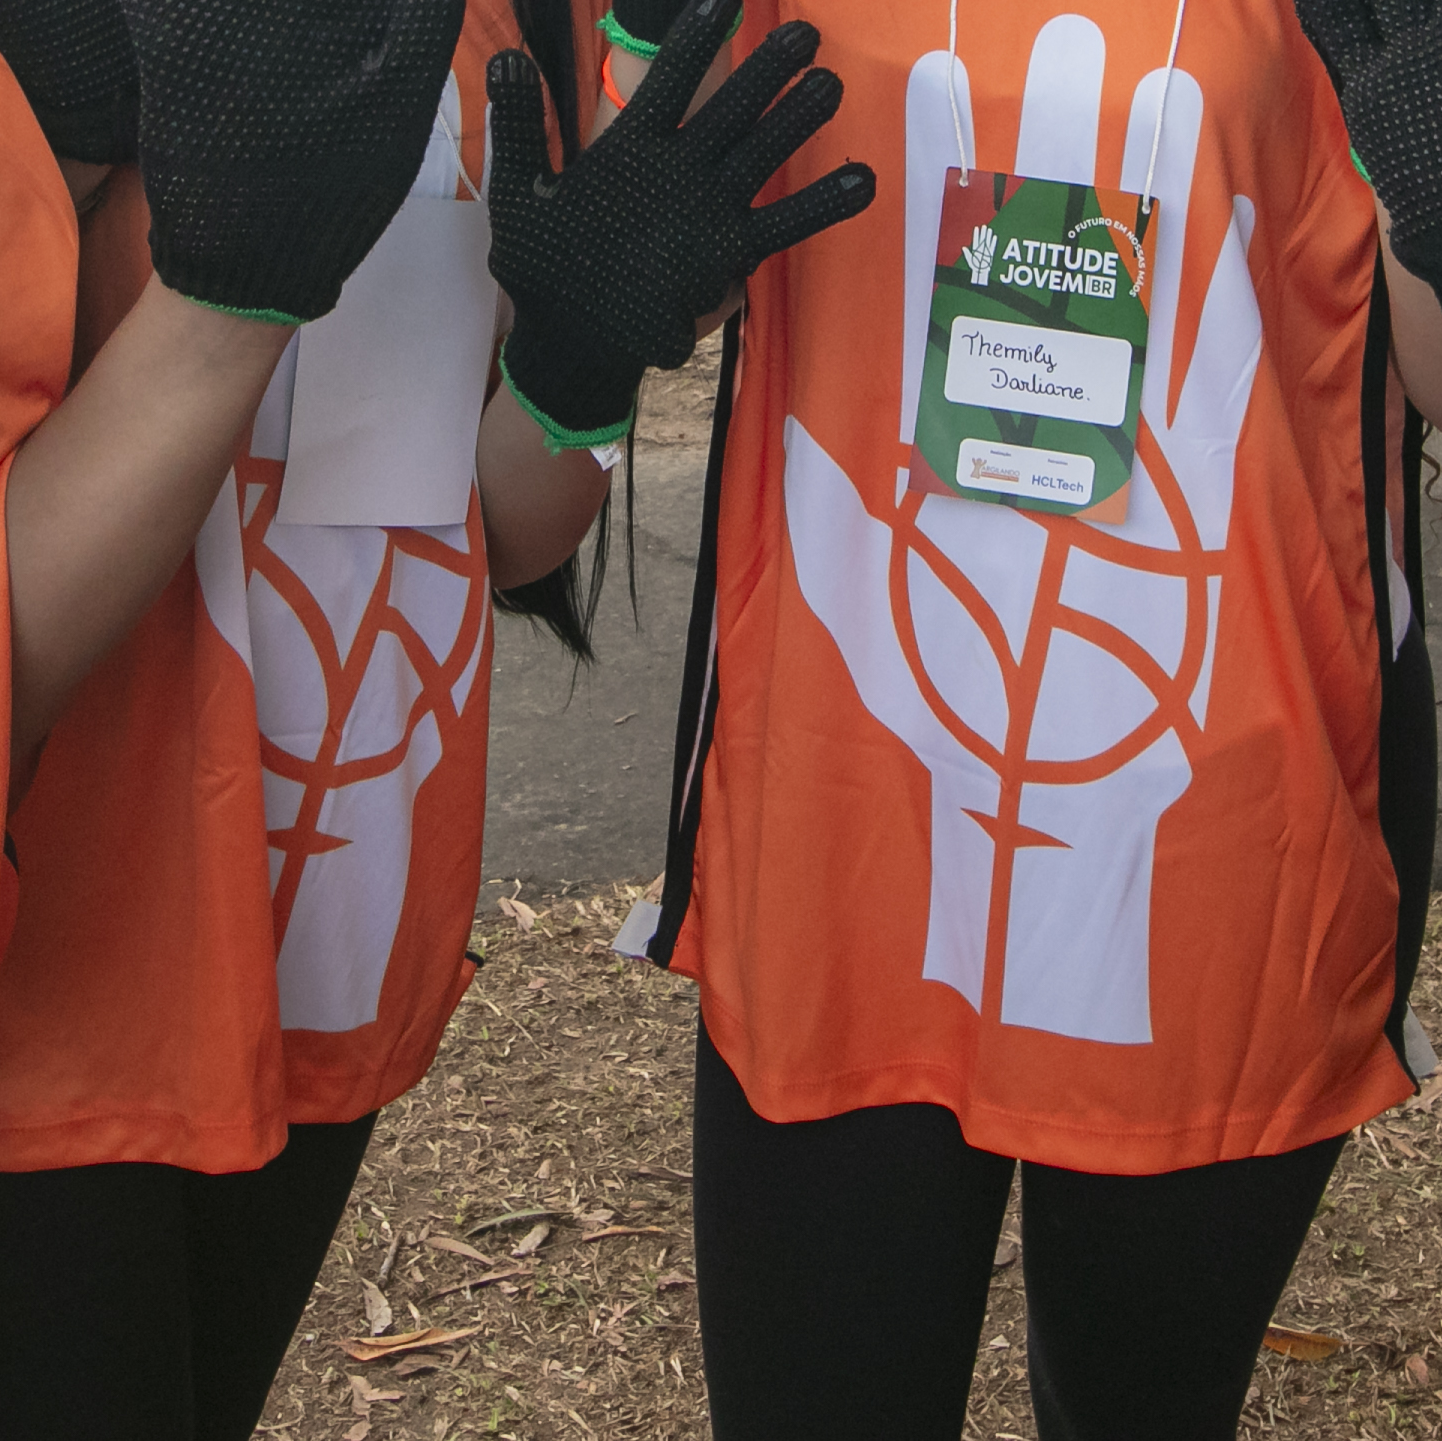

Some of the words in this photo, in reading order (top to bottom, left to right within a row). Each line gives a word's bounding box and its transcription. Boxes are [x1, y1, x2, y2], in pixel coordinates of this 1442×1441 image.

[1002, 238, 1119, 275] ATITUDE
[1074, 217, 1112, 233] FUTURO
[1113, 221, 1128, 234] EM
[1126, 230, 1146, 269] NOSSAS
[999, 263, 1083, 295] JOVEM
[1031, 474, 1085, 493] HCLTech
